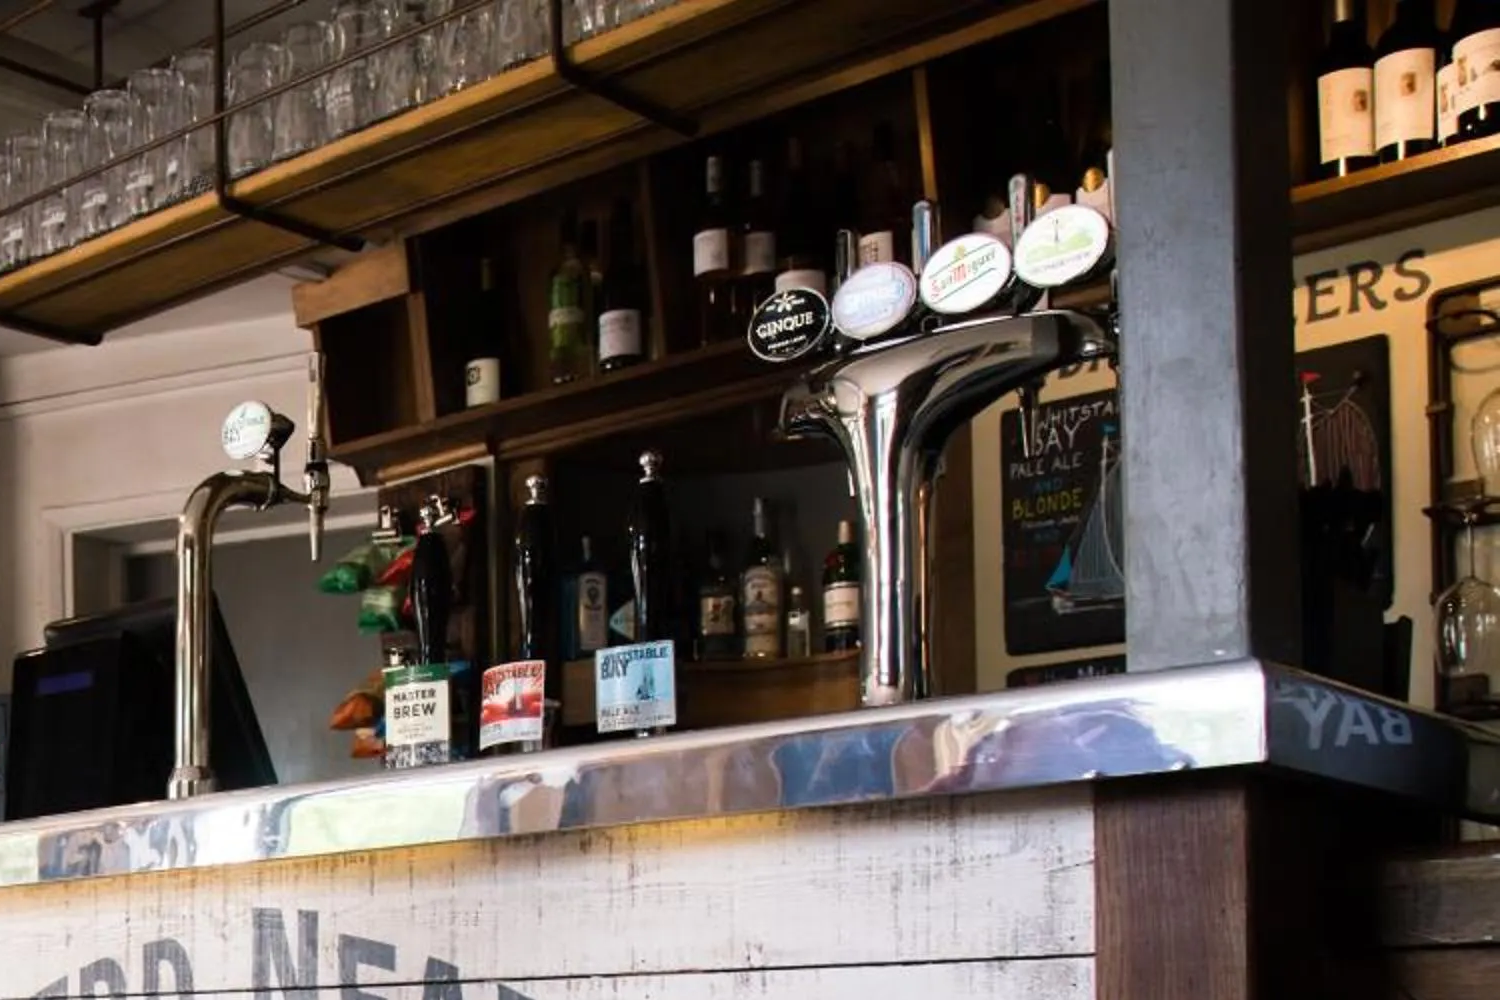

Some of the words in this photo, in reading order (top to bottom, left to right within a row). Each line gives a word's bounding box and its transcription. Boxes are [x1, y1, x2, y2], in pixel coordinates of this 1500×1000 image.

[755, 311, 815, 340] CINQUE
[1033, 418, 1083, 457] BAY
[1009, 458, 1045, 480] PALE
[1051, 451, 1084, 471] ALE
[1011, 486, 1084, 521] BLONDE
[393, 688, 436, 704] MASTER
[393, 702, 437, 720] BREW
